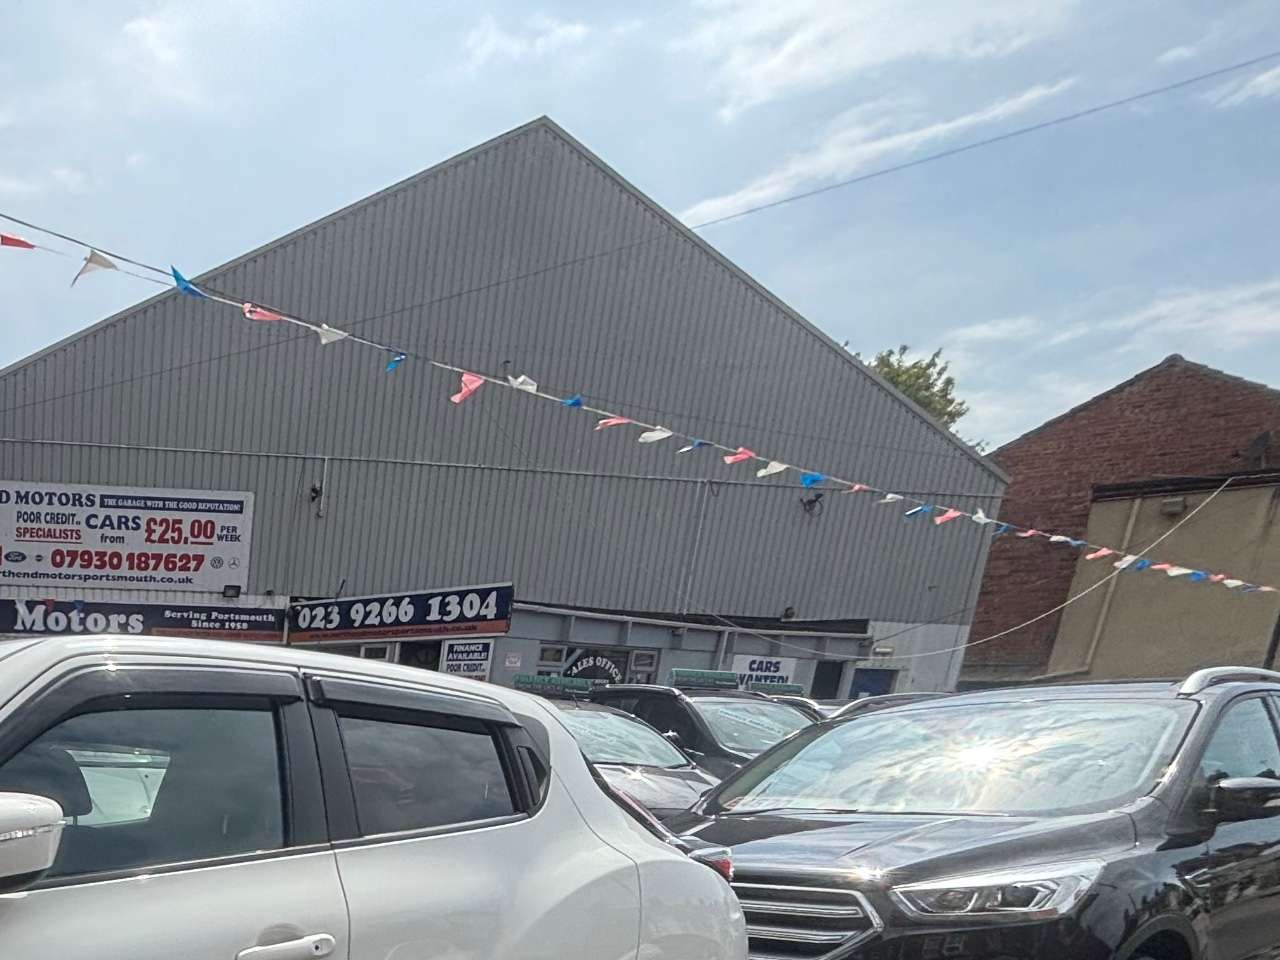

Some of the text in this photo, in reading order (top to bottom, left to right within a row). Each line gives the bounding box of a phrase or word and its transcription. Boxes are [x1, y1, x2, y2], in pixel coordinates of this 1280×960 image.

[14, 490, 96, 508] MOTORS
[104, 498, 117, 506] THE
[145, 500, 164, 508] WITH
[165, 501, 178, 509] THE
[179, 502, 197, 510] GOOD
[16, 511, 41, 523] POOR
[85, 514, 141, 531] CARS
[15, 527, 82, 541] SPECIALISTS
[145, 517, 216, 545] £25.00
[221, 526, 237, 534] PER
[100, 534, 125, 543] from
[217, 534, 241, 542] WEEK
[51, 549, 205, 572] 07930 187627
[164, 610, 275, 622] Serving Portsmouth
[297, 590, 497, 629] 023 9266 1304
[14, 600, 145, 634] Motors
[191, 620, 220, 628] Since
[453, 644, 483, 652] FINANCE
[567, 656, 622, 683] ALES OFFICE
[749, 660, 781, 673] CARS
